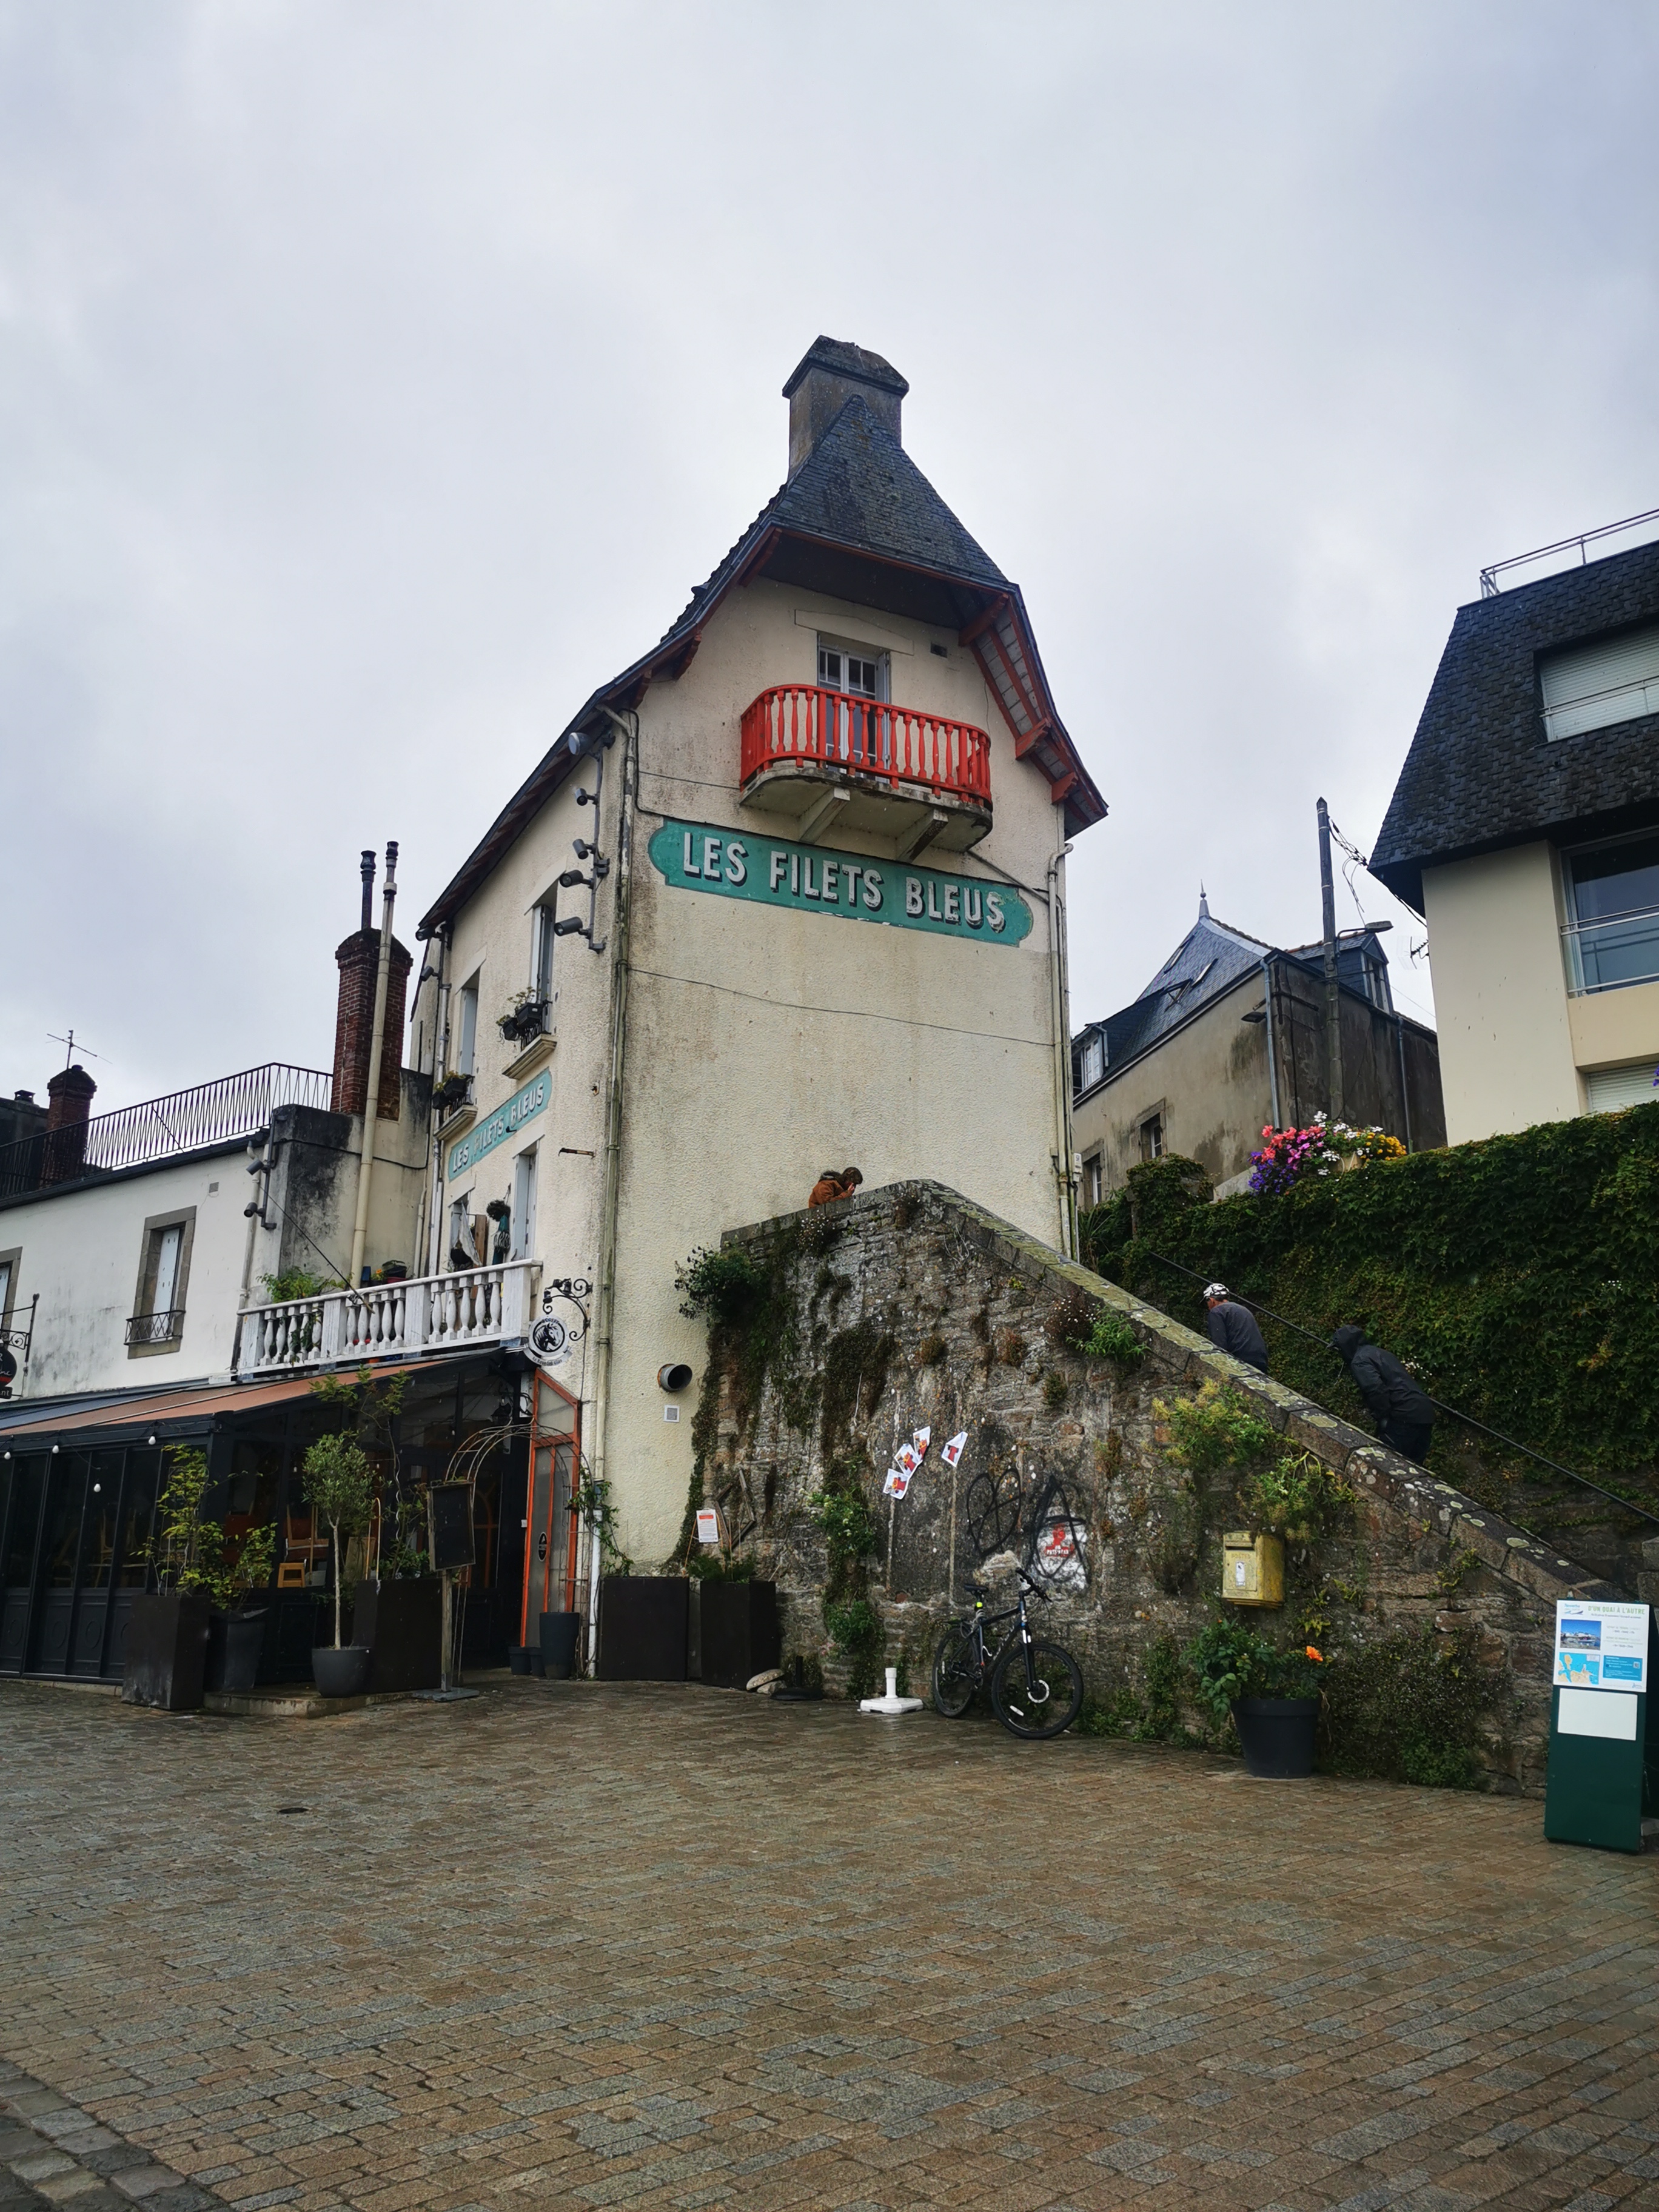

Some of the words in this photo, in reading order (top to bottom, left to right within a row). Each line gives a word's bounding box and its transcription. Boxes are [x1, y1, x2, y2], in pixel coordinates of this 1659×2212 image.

[683, 832, 748, 886] LES
[769, 850, 885, 913] FILETS
[905, 876, 1007, 934] BLEUS
[453, 1143, 469, 1173] LES
[474, 1114, 504, 1156] FILETS
[510, 1082, 544, 1128] BLEUS
